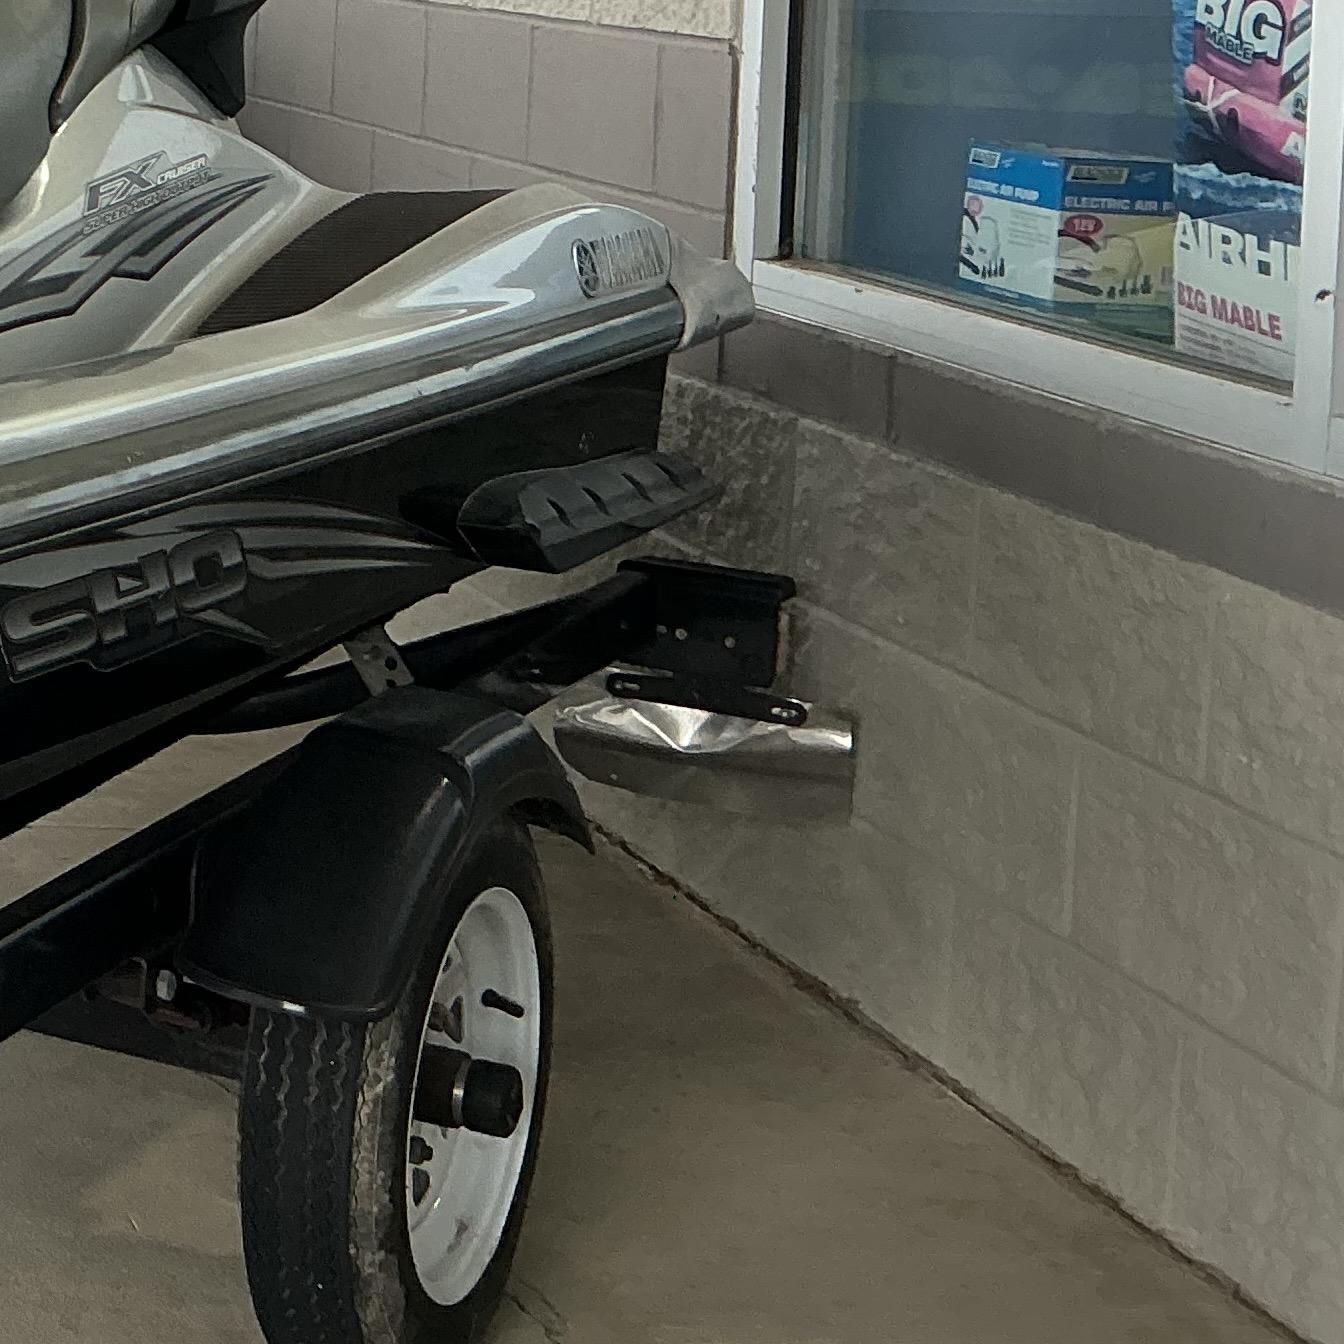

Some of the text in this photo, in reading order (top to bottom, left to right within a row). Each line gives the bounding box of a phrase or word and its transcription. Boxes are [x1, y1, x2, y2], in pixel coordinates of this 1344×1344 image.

[1205, 26, 1255, 64] MABLE
[85, 152, 208, 214] FX CRUISER
[1064, 196, 1131, 210] ELECTRIC
[1134, 199, 1159, 211] AIR
[1177, 282, 1282, 342] BIG MABLE
[0, 528, 248, 675] SHO
